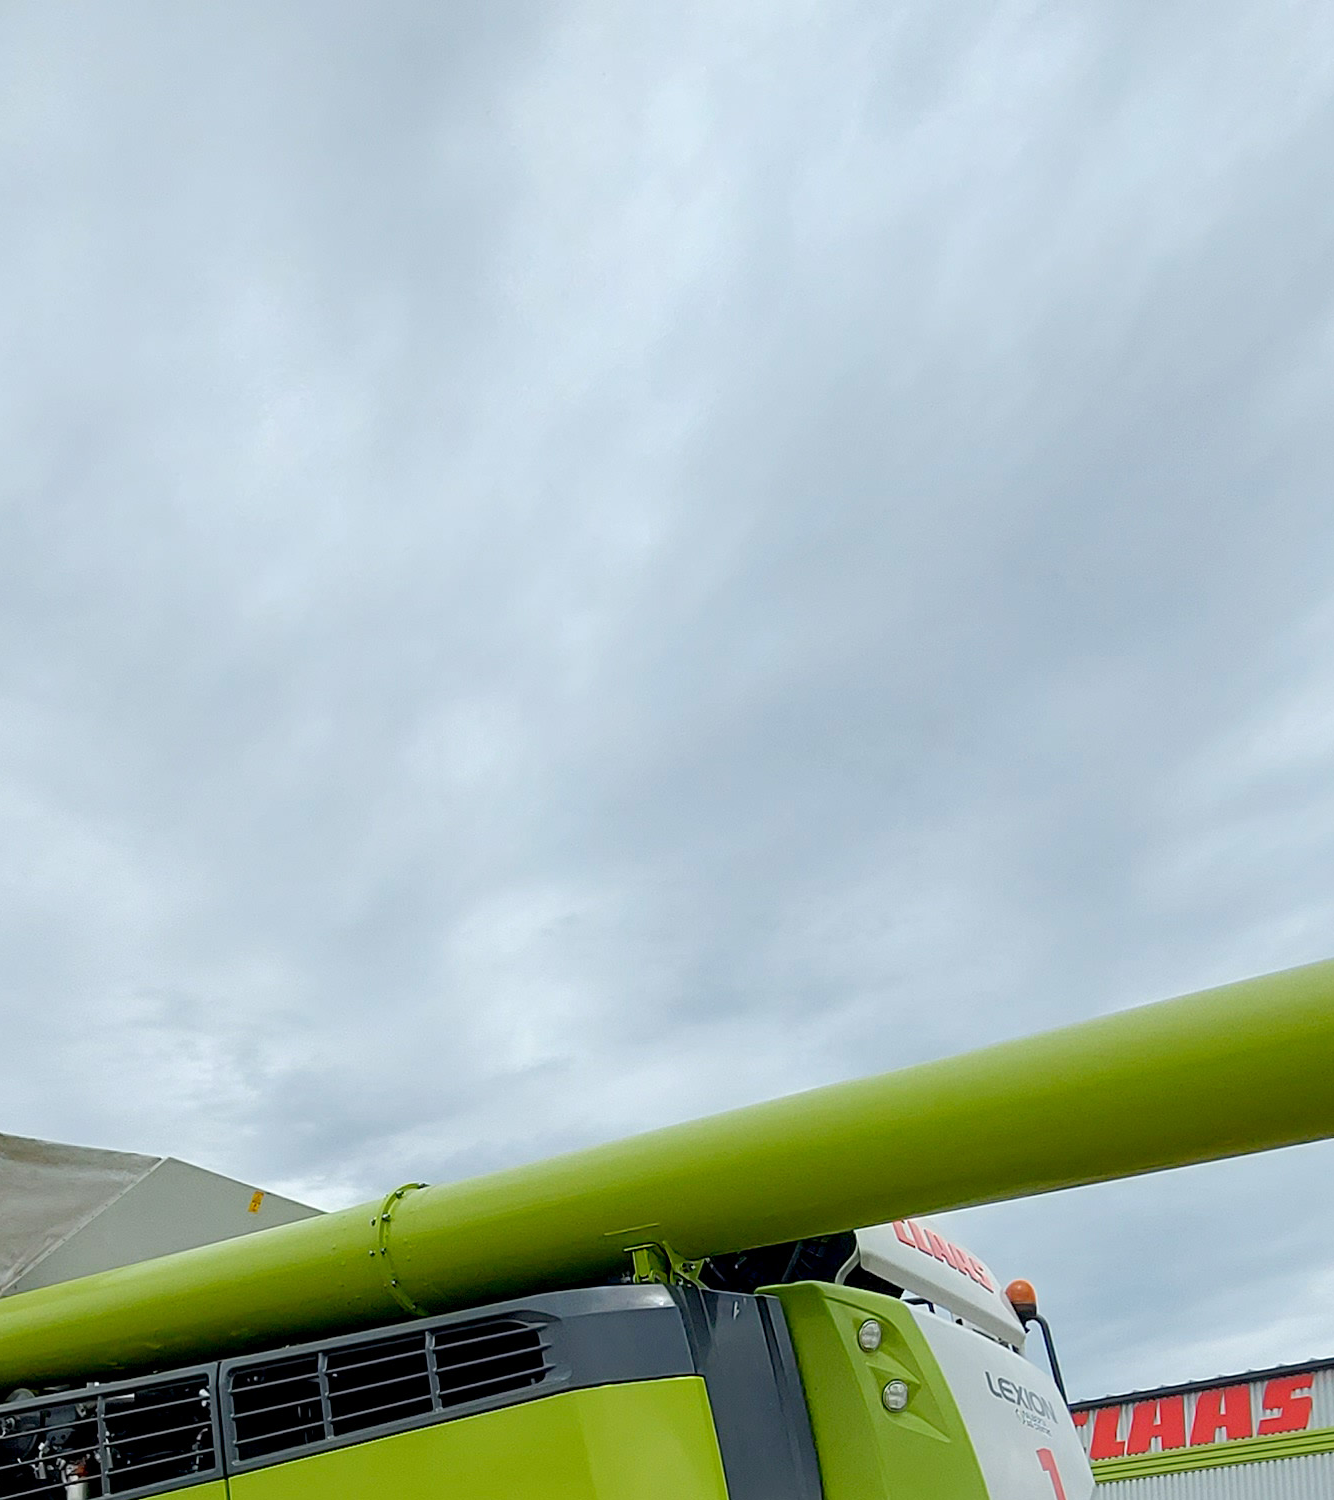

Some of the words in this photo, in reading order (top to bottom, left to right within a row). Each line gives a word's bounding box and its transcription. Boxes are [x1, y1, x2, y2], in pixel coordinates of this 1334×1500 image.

[892, 1219, 995, 1294] CLAAS
[984, 1370, 1059, 1425] LEXION
[1071, 1373, 1315, 1460] LAAS
